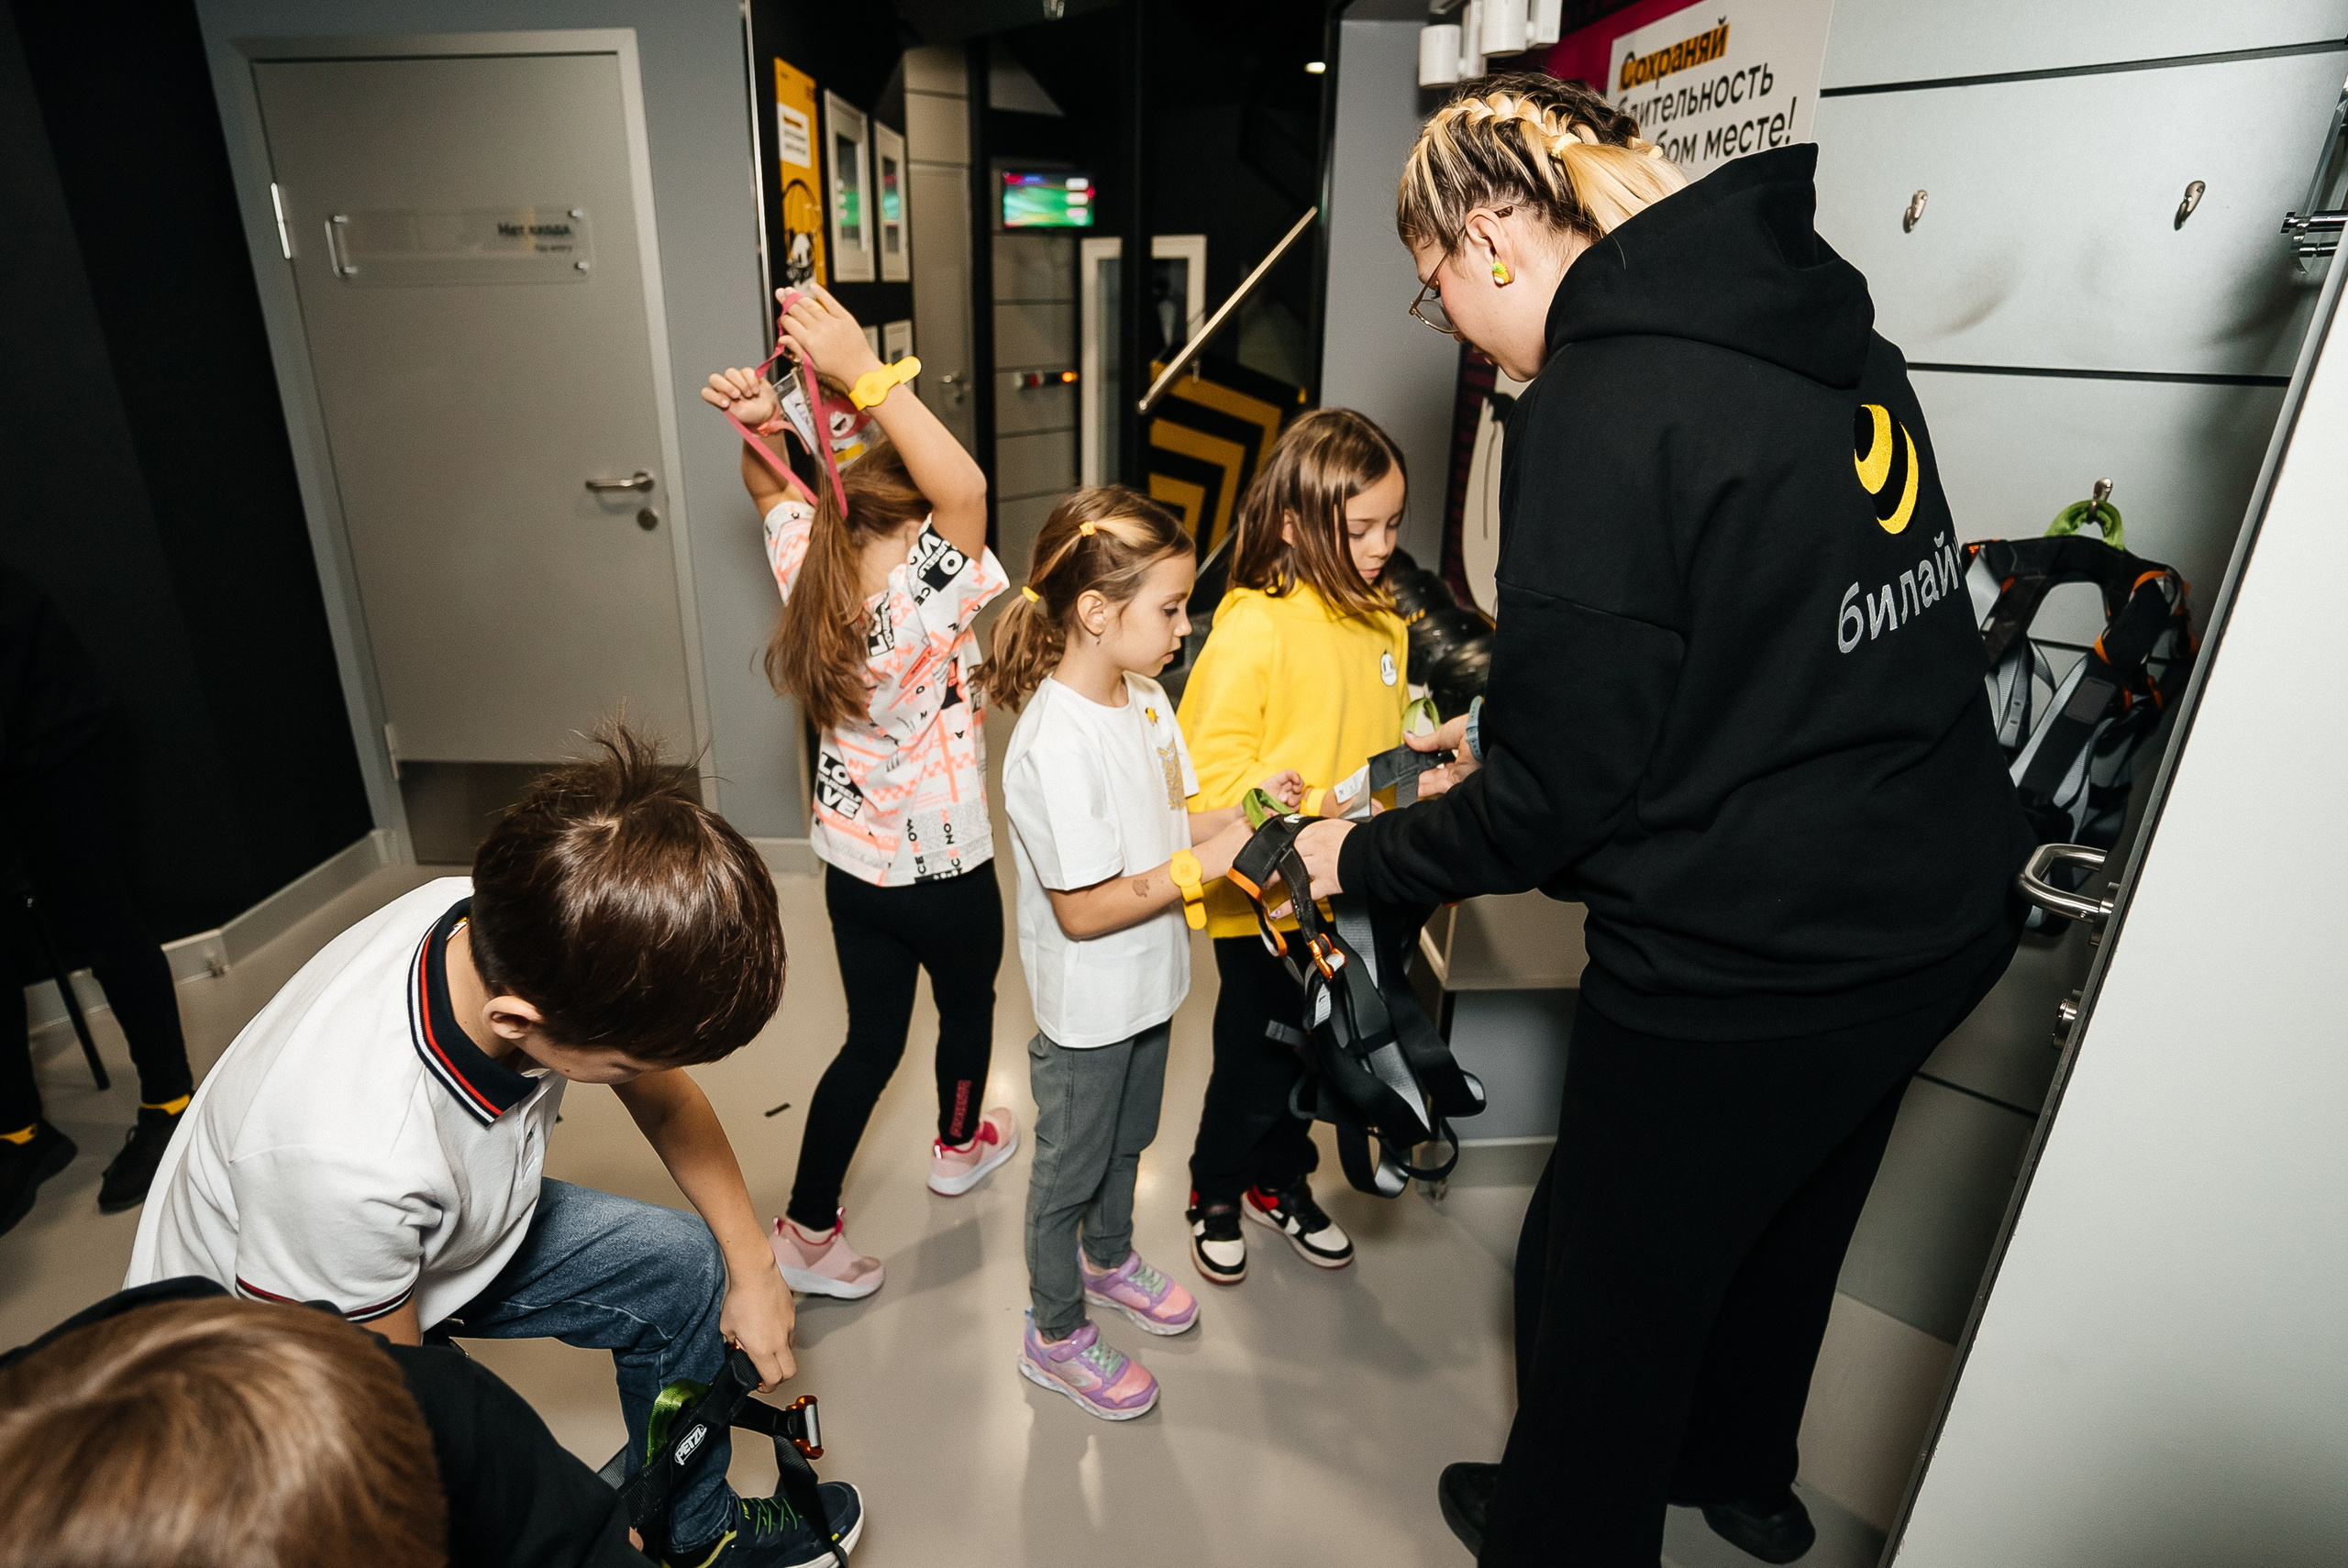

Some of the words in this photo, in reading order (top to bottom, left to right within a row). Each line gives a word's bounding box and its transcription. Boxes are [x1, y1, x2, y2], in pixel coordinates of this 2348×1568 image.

[1620, 16, 1730, 90] Сохраняй
[1656, 129, 1697, 163] бом
[1703, 96, 1797, 160] месте!
[675, 1426, 707, 1465] PETZL
